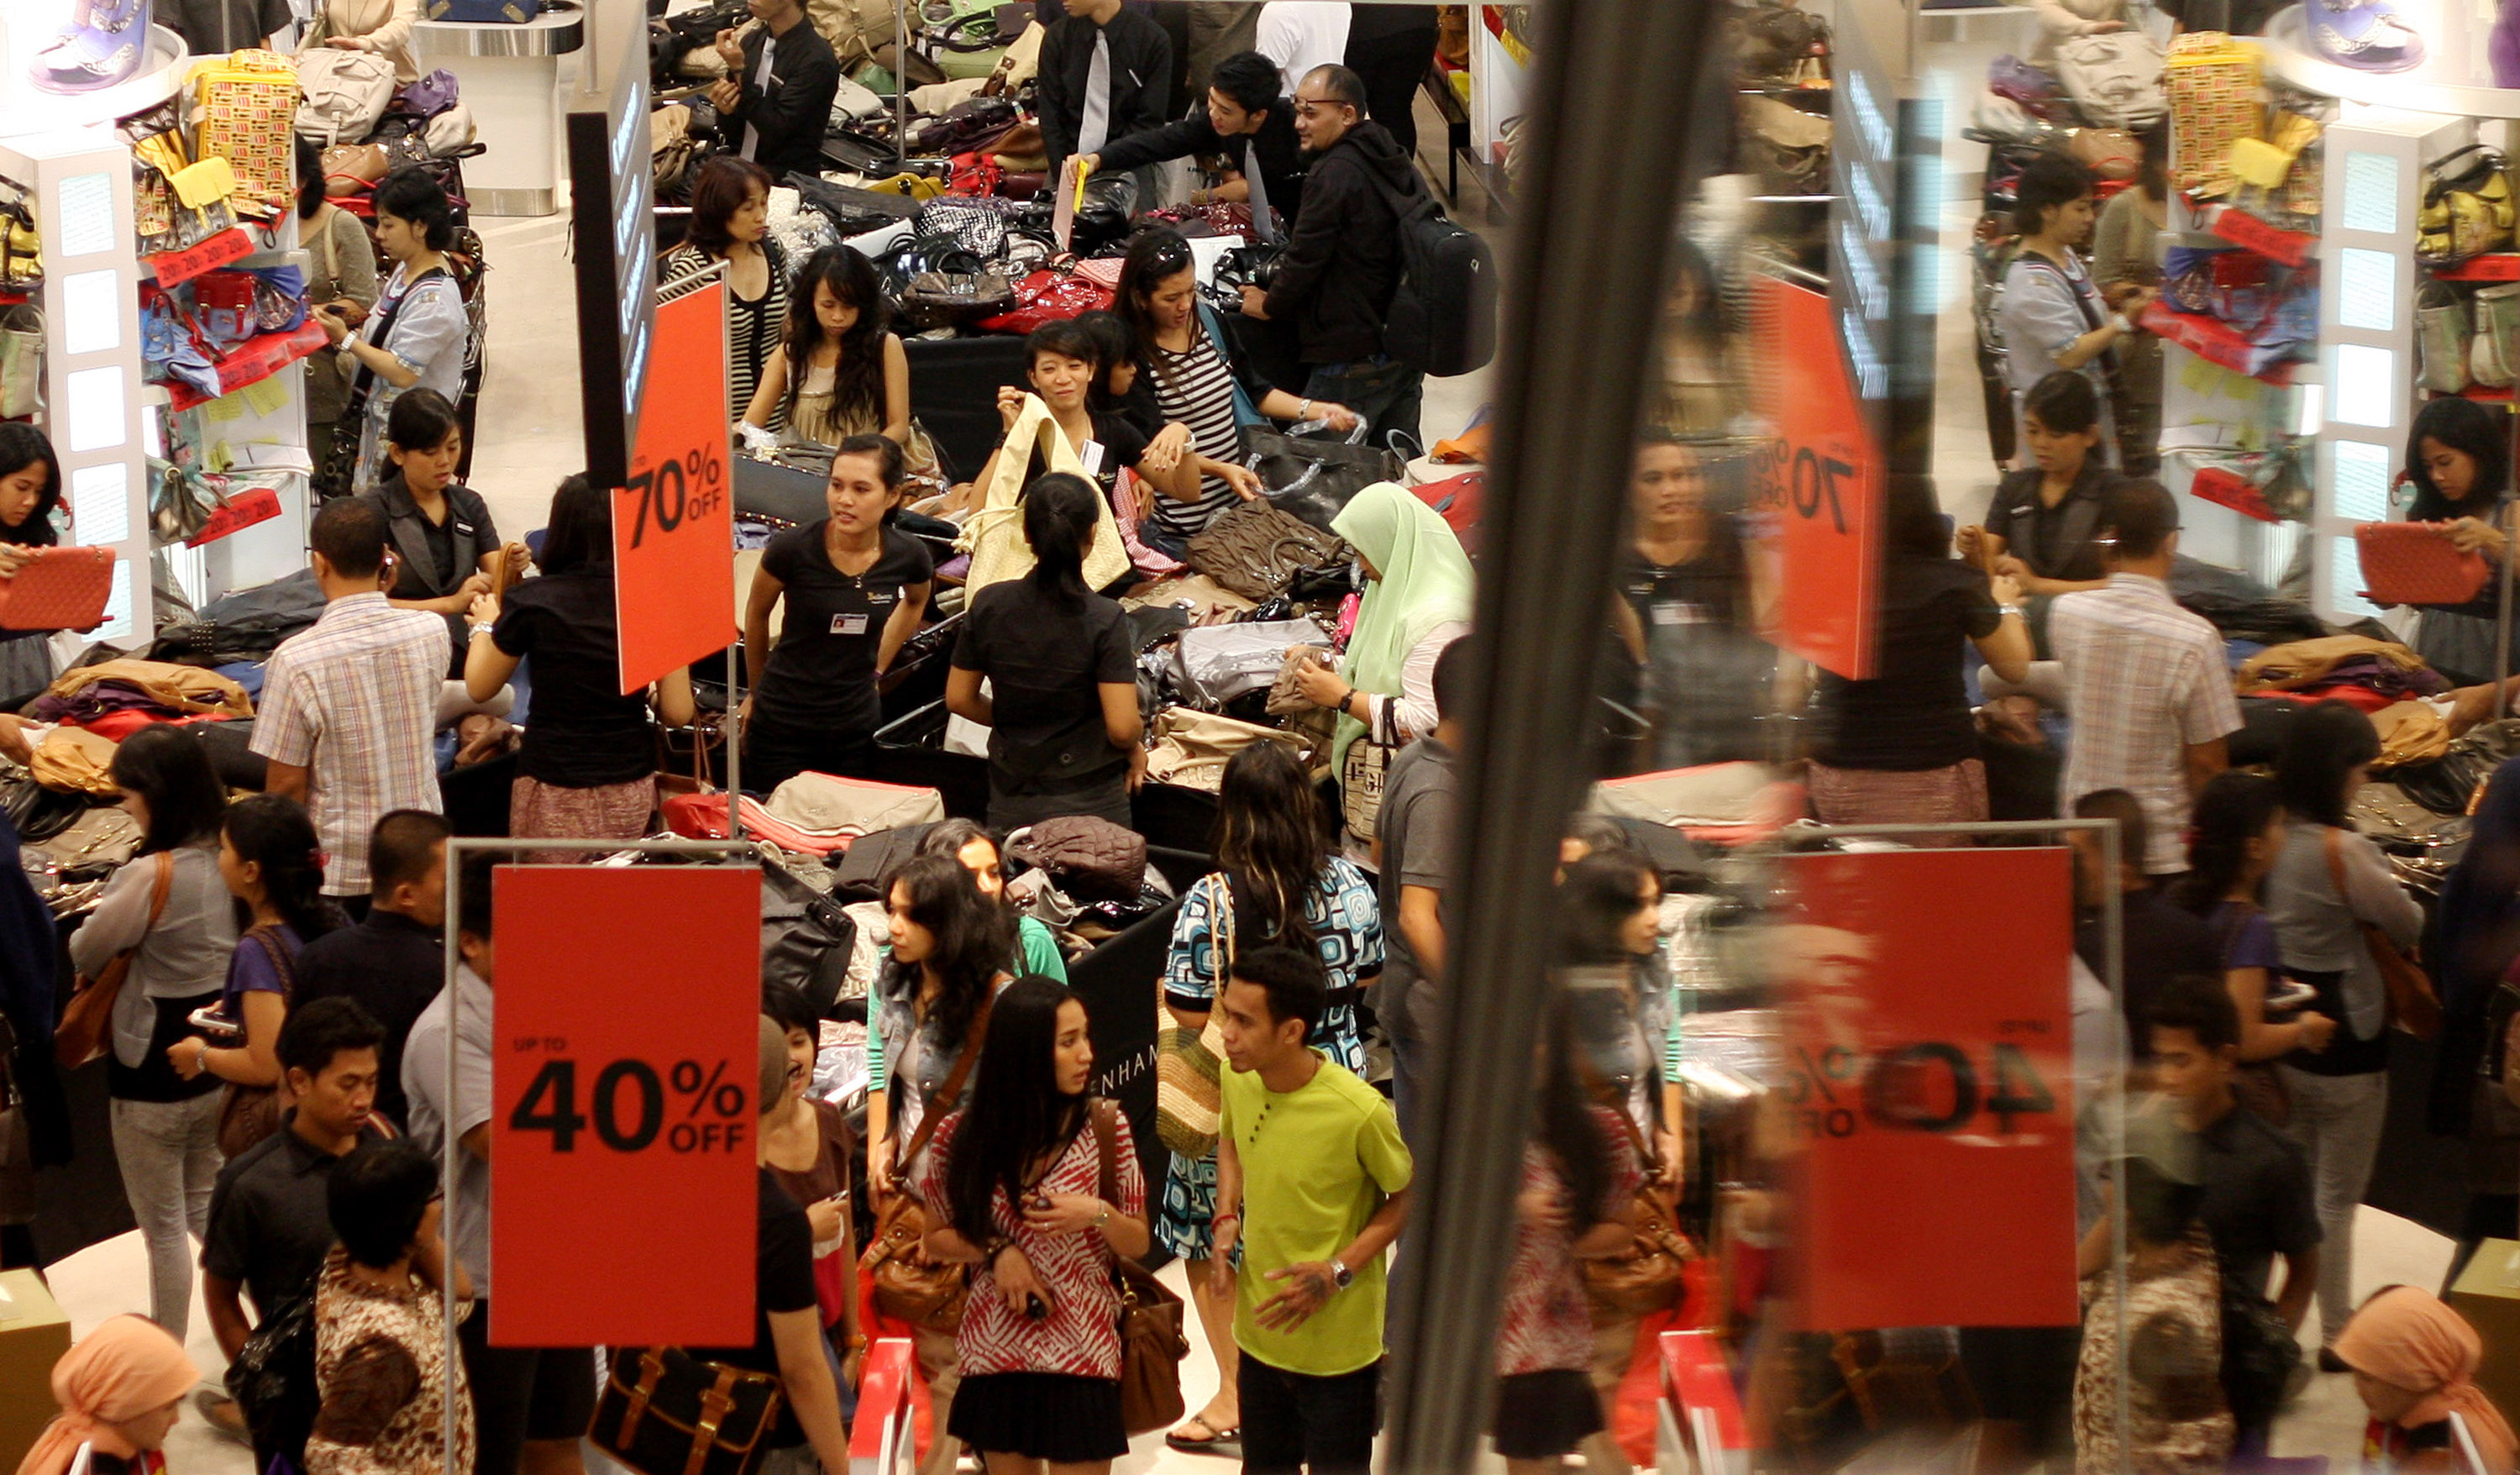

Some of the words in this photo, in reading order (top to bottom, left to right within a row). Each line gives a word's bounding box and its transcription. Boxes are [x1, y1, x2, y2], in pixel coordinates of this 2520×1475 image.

[689, 487, 721, 520] OFF
[513, 1038, 538, 1052] UP
[545, 1038, 567, 1052] TO
[509, 1058, 745, 1153] 40%
[669, 1123, 746, 1153] OFF
